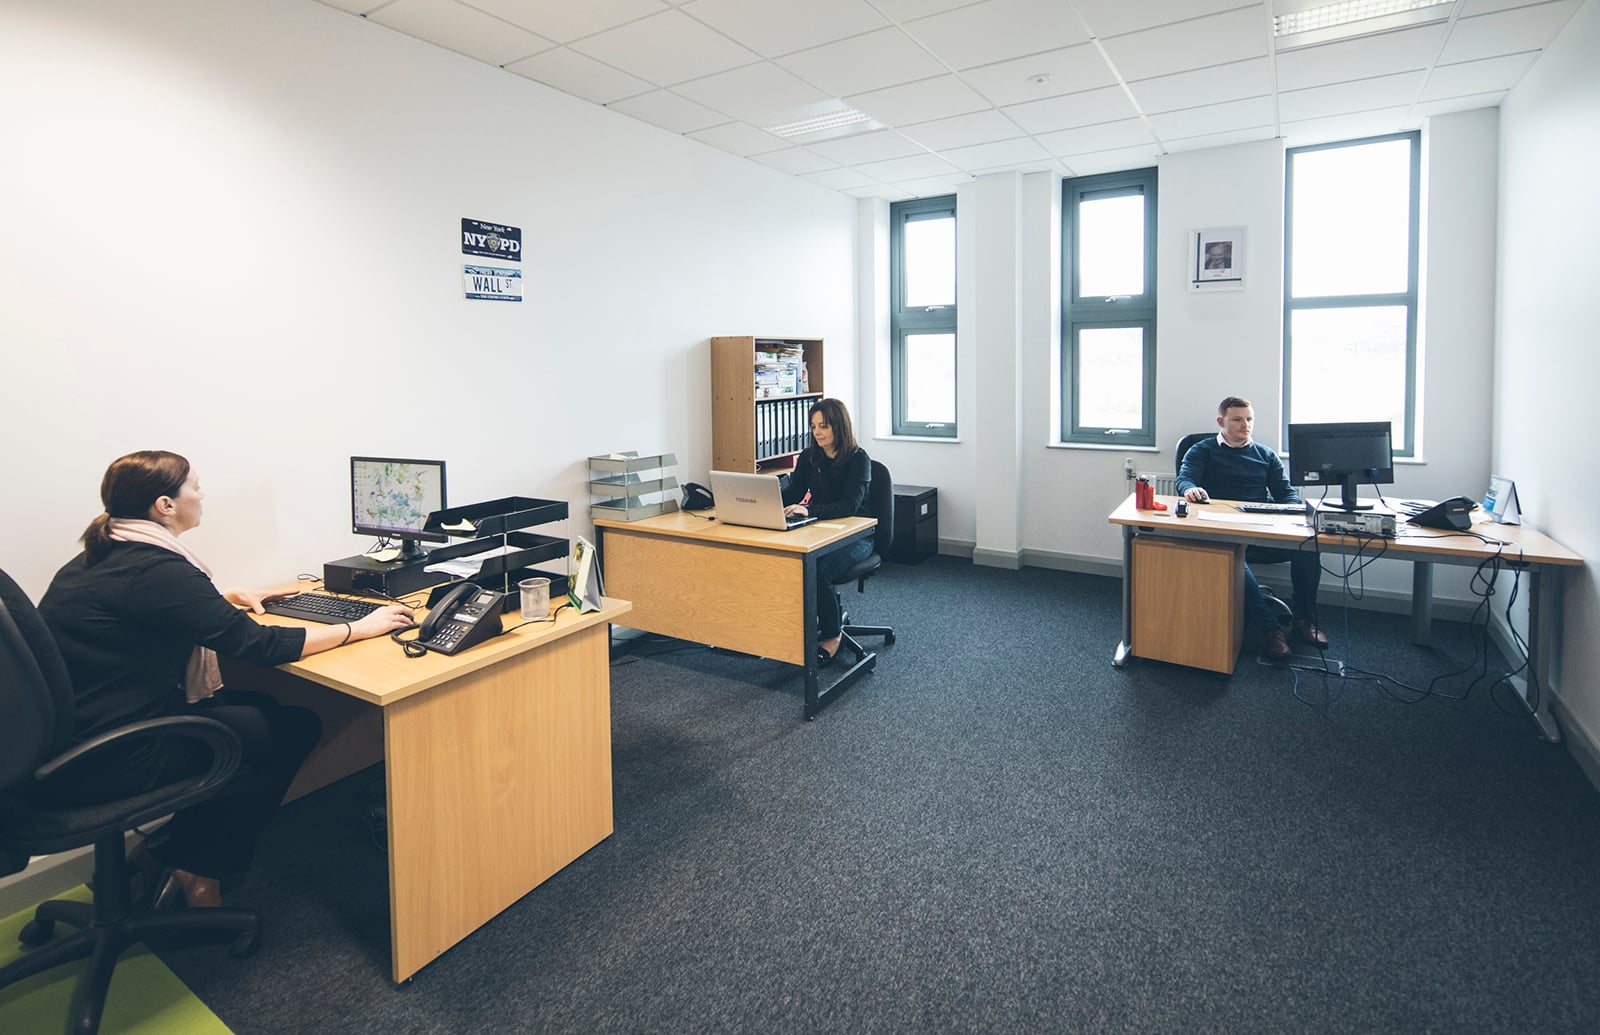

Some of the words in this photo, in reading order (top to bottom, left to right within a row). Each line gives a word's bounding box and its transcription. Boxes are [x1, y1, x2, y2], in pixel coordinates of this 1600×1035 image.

[480, 223, 492, 231] New
[493, 225, 505, 233] York
[473, 276, 503, 293] WALL
